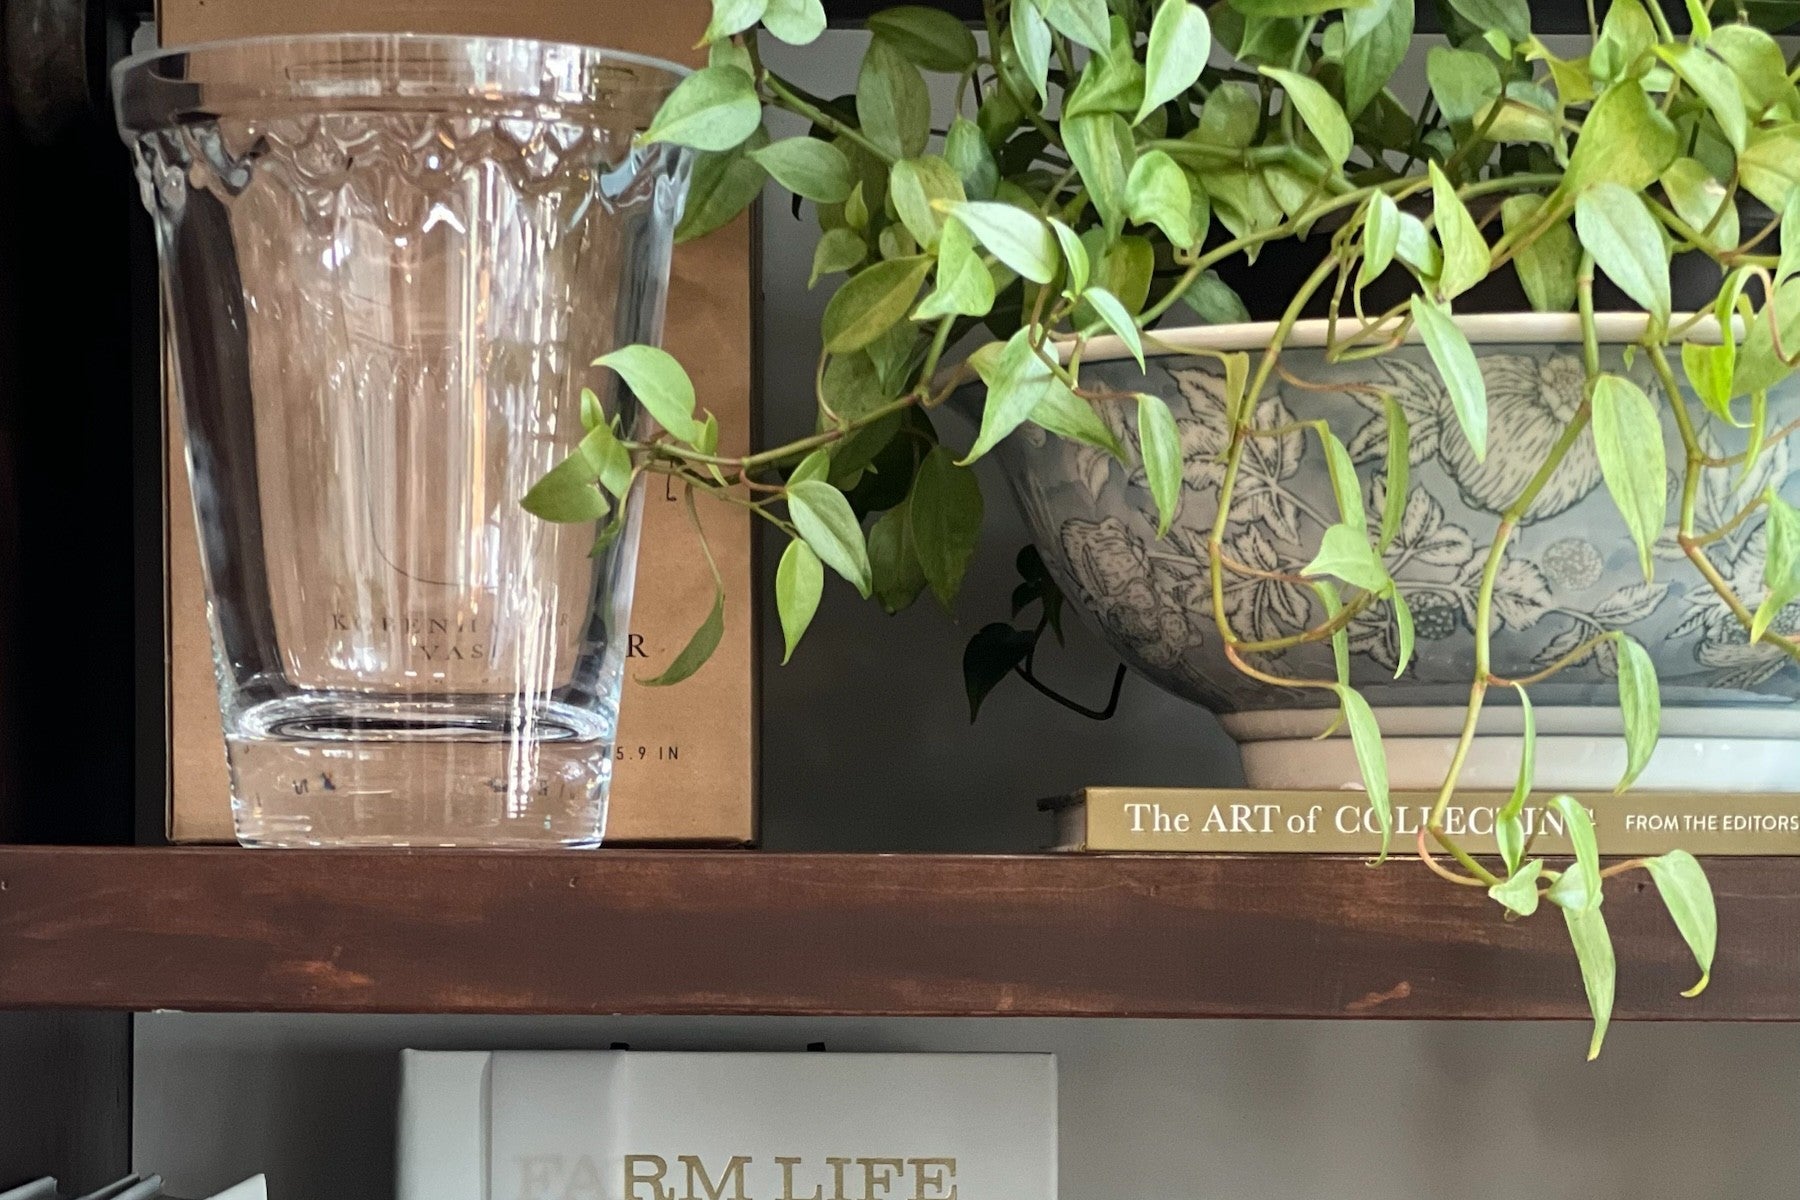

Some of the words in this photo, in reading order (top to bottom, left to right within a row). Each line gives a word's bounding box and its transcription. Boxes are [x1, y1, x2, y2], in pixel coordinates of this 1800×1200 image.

[659, 746, 679, 760] IN
[1124, 803, 1190, 833] The
[1201, 804, 1281, 834] ART
[1286, 805, 1333, 834] of
[1625, 814, 1680, 831] FROM
[1683, 815, 1719, 831] THE
[1722, 815, 1800, 831] EDITORS
